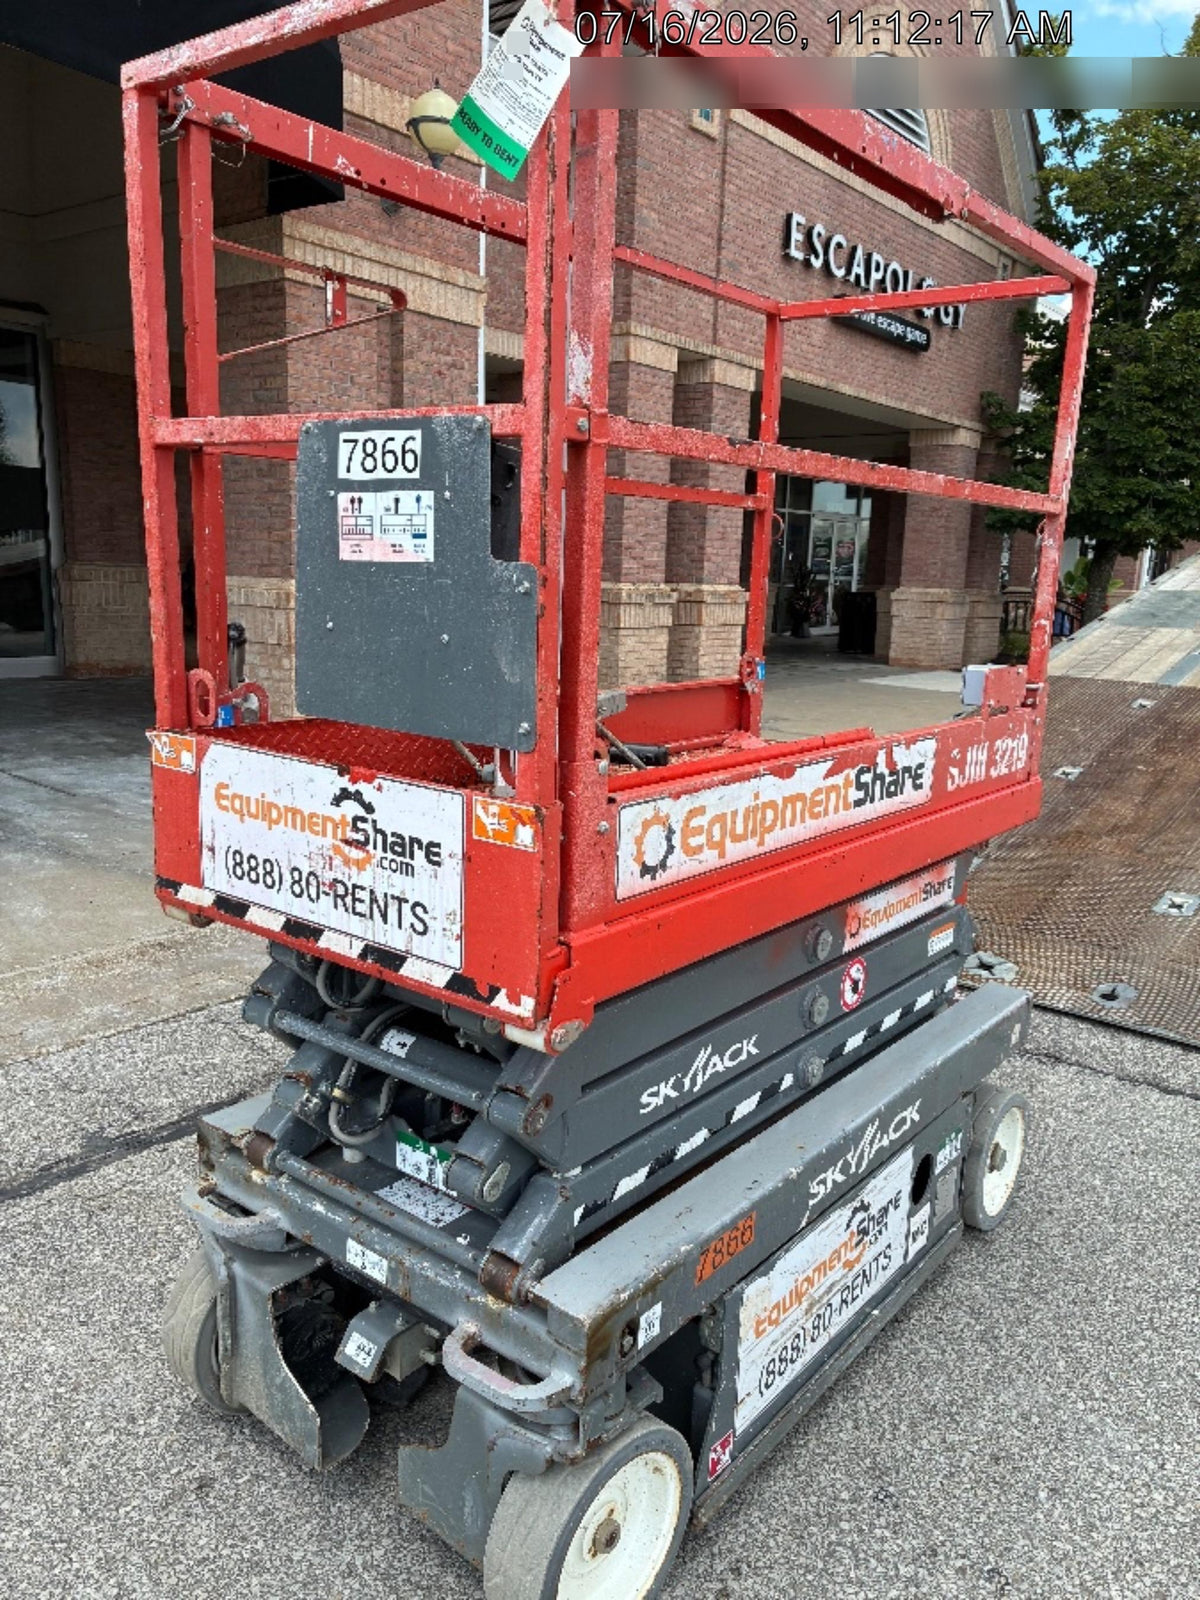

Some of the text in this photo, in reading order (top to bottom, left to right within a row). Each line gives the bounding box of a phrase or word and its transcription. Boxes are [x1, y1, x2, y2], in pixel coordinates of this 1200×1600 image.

[877, 315, 906, 337] escape
[905, 326, 929, 345] game
[342, 435, 419, 474] 7866
[989, 733, 1029, 779] 3219
[224, 844, 430, 937] (888) 80-RENTS
[638, 1033, 760, 1115] SKYJACK
[808, 1098, 922, 1208] SKYJACK
[696, 1212, 754, 1284] 7866
[757, 1323, 808, 1398] (888)
[809, 1242, 893, 1344] 80-RENTS
